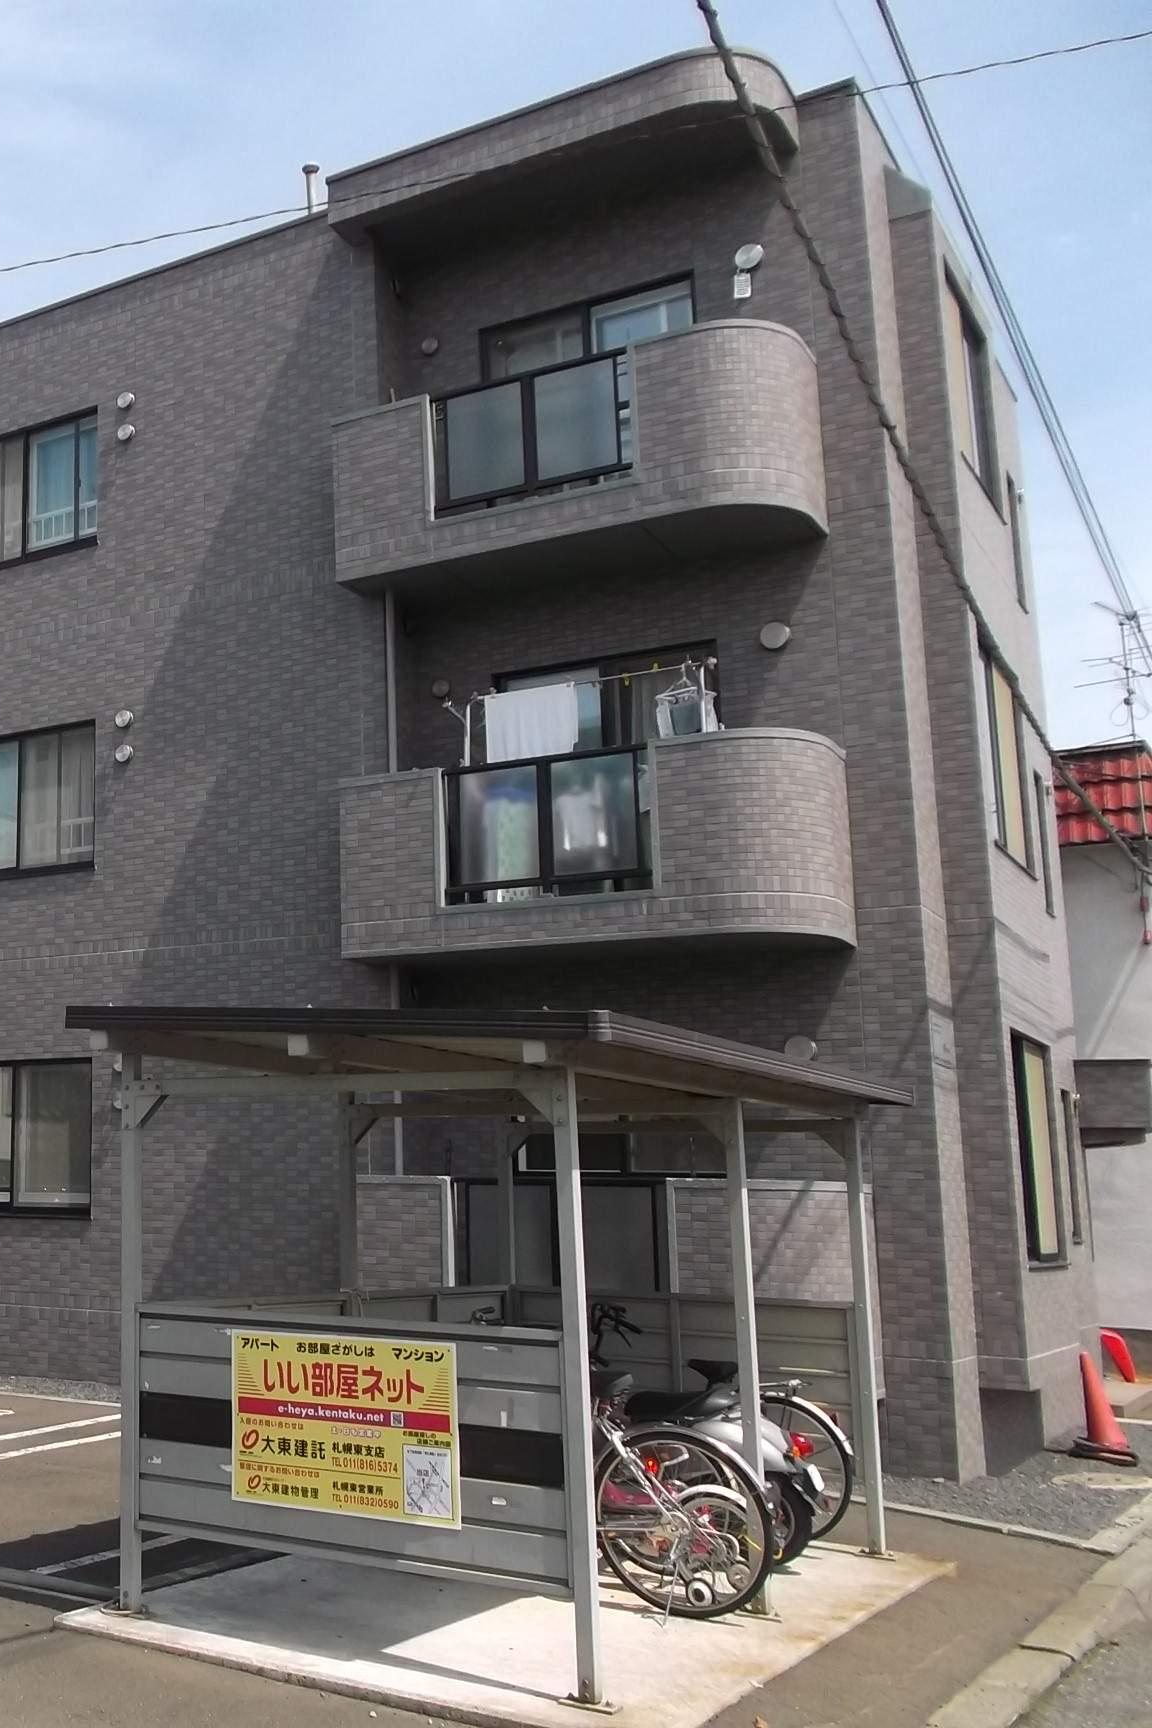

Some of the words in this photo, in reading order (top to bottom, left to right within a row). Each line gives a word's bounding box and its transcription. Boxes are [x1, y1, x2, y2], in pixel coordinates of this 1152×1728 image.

[240, 1337, 279, 1352] アパート
[391, 1347, 445, 1363] マンション
[263, 1359, 425, 1405] いい部屋ネット
[277, 1404, 385, 1423] e-heya.kentaku.net
[261, 1435, 326, 1460] 大東建託
[331, 1439, 385, 1459] 札幌東支店
[262, 1481, 319, 1500] 大東建物管理
[332, 1481, 384, 1497] 札幌東営業所
